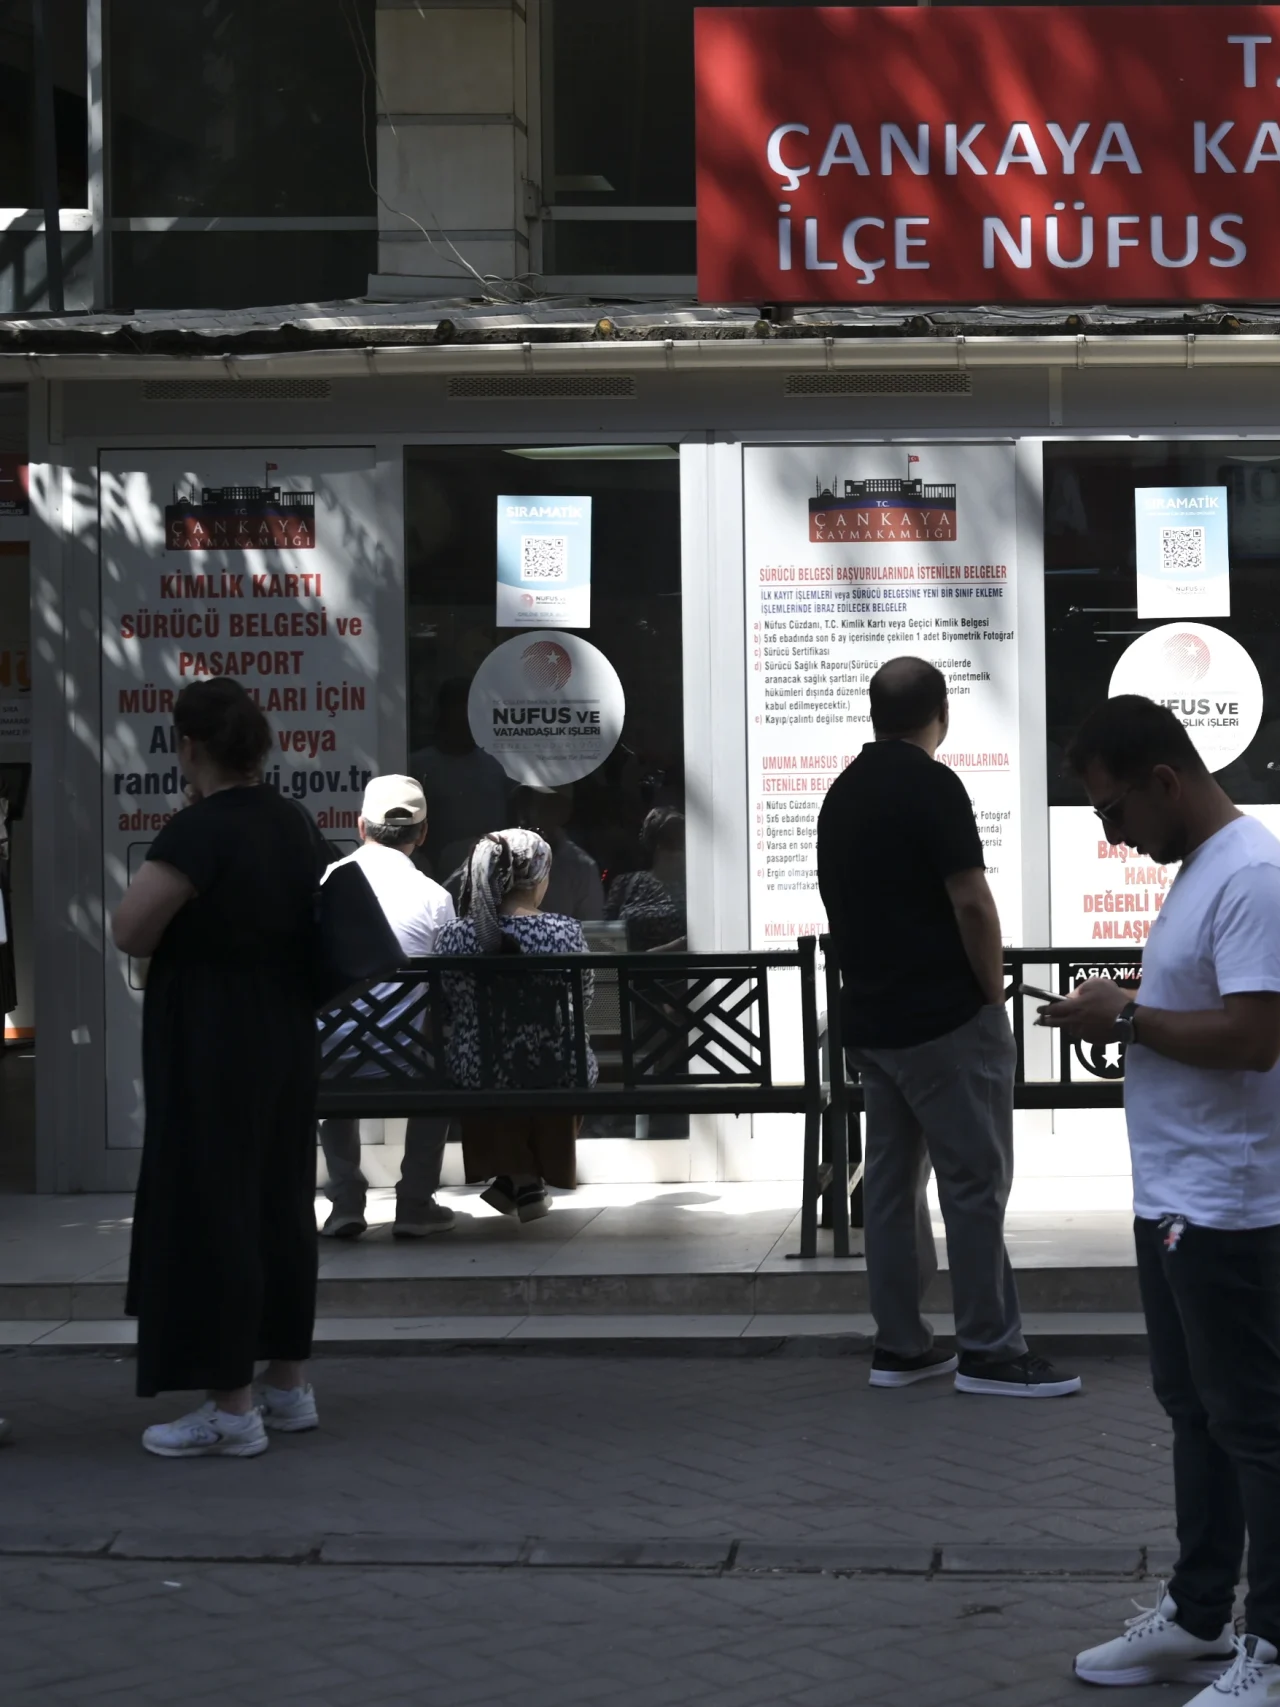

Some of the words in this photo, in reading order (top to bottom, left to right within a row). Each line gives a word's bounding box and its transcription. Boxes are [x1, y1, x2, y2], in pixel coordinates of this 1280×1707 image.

[766, 122, 1141, 191] ÇANKAYA
[779, 203, 930, 284] İLÇE
[983, 202, 1246, 269] NÜFUS
[172, 520, 308, 537] ÇANKAYA
[814, 512, 950, 530] ÇANKAYA
[815, 527, 951, 540] KAYMAKAMLIĞI
[759, 565, 795, 582] SÜRÜCÜ
[798, 564, 834, 581] BELGESİ
[836, 566, 915, 584] BAŞVURULARINDA
[917, 562, 961, 584] İSTENİLEN
[963, 564, 1007, 583] BELGELER
[160, 569, 244, 598] KİMLİK
[253, 574, 322, 598] KARTI
[761, 591, 771, 600] İLK
[774, 590, 793, 600] KAYIT
[795, 590, 832, 600] İŞLEMLERİ
[834, 591, 851, 601] veya
[851, 586, 881, 600] SÜRÜCÜ
[883, 588, 921, 599] BELGESİNE
[922, 588, 939, 598] YENİ
[940, 586, 954, 598] BİR
[954, 588, 973, 598] SINIF
[975, 587, 1003, 598] EKLEME
[761, 603, 812, 614] İŞLEMLERİNDE
[814, 603, 835, 613] İBRAZ
[836, 601, 871, 613] EDİLECEK
[872, 602, 907, 612] BELGELER
[120, 608, 220, 639] SÜRÜCÜ
[230, 606, 327, 636] BELGESİ
[336, 617, 362, 636] ve
[764, 620, 787, 629] Nüfus
[788, 620, 822, 629] Cüzdanı,
[824, 619, 838, 628] T.C.
[841, 619, 865, 628] Kimlik
[867, 619, 886, 628] Kartı
[888, 620, 906, 630] veya
[908, 618, 932, 628] Geçici
[934, 618, 959, 627] Kimlik
[960, 617, 989, 629] Belgesi
[763, 647, 790, 656] Sürücü
[792, 646, 830, 656] Sertifikası
[179, 651, 304, 676] PASAPORT
[316, 681, 365, 717] İÇİN
[493, 707, 572, 724] NÜFUS
[576, 711, 600, 724] VE
[1215, 702, 1239, 715] VE
[493, 727, 566, 738] VATANDAŞLIK
[278, 728, 336, 758] veya
[762, 756, 797, 770] UMUMA
[800, 755, 838, 769] MAHSUS
[762, 776, 807, 792] İSTENİLEN
[1083, 888, 1149, 913] DEĞERLİ
